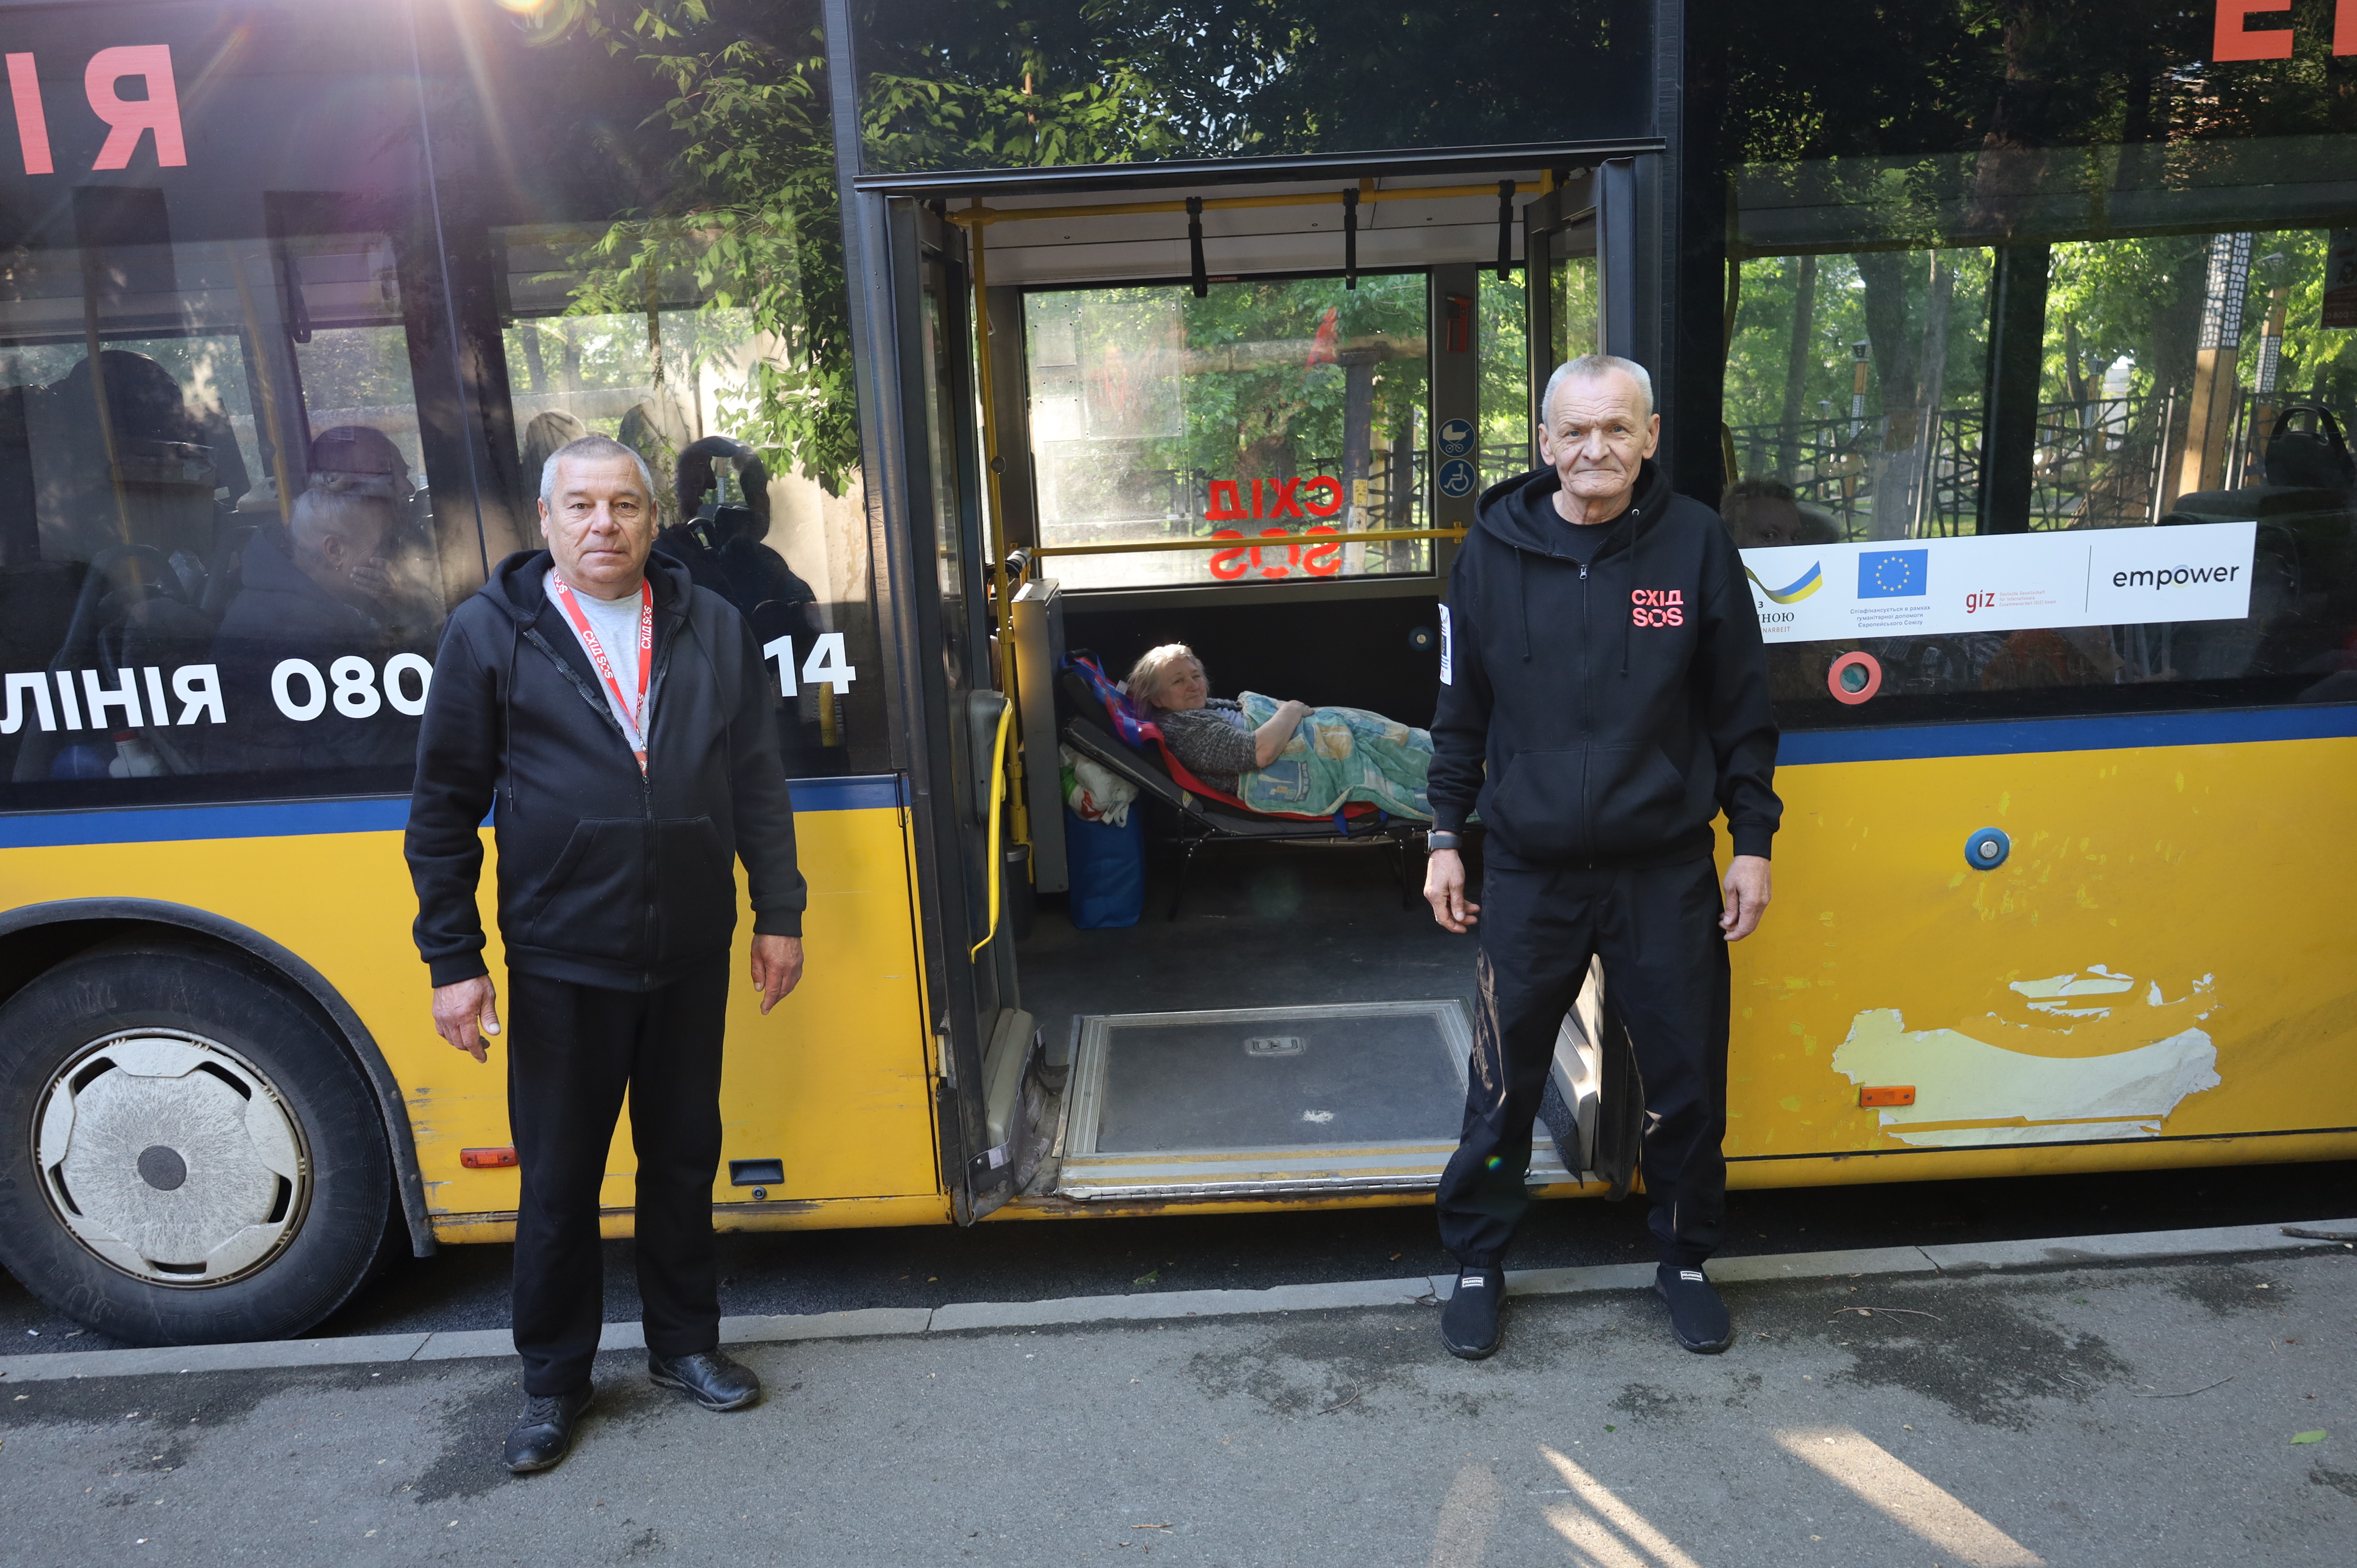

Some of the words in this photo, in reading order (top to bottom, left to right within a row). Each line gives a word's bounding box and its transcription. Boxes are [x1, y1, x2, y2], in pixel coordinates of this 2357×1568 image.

[2113, 566, 2239, 590] empower
[1632, 589, 1684, 607] СХІД
[1966, 589, 1995, 613] giz
[643, 605, 652, 625] SOS
[1632, 607, 1684, 628] SOS
[641, 625, 652, 649] СХІД
[582, 630, 603, 656] СХІД
[597, 656, 614, 679] SOS
[0, 664, 227, 734] ЛІНІЯ
[271, 653, 433, 721] 080
[763, 632, 856, 697] 14
